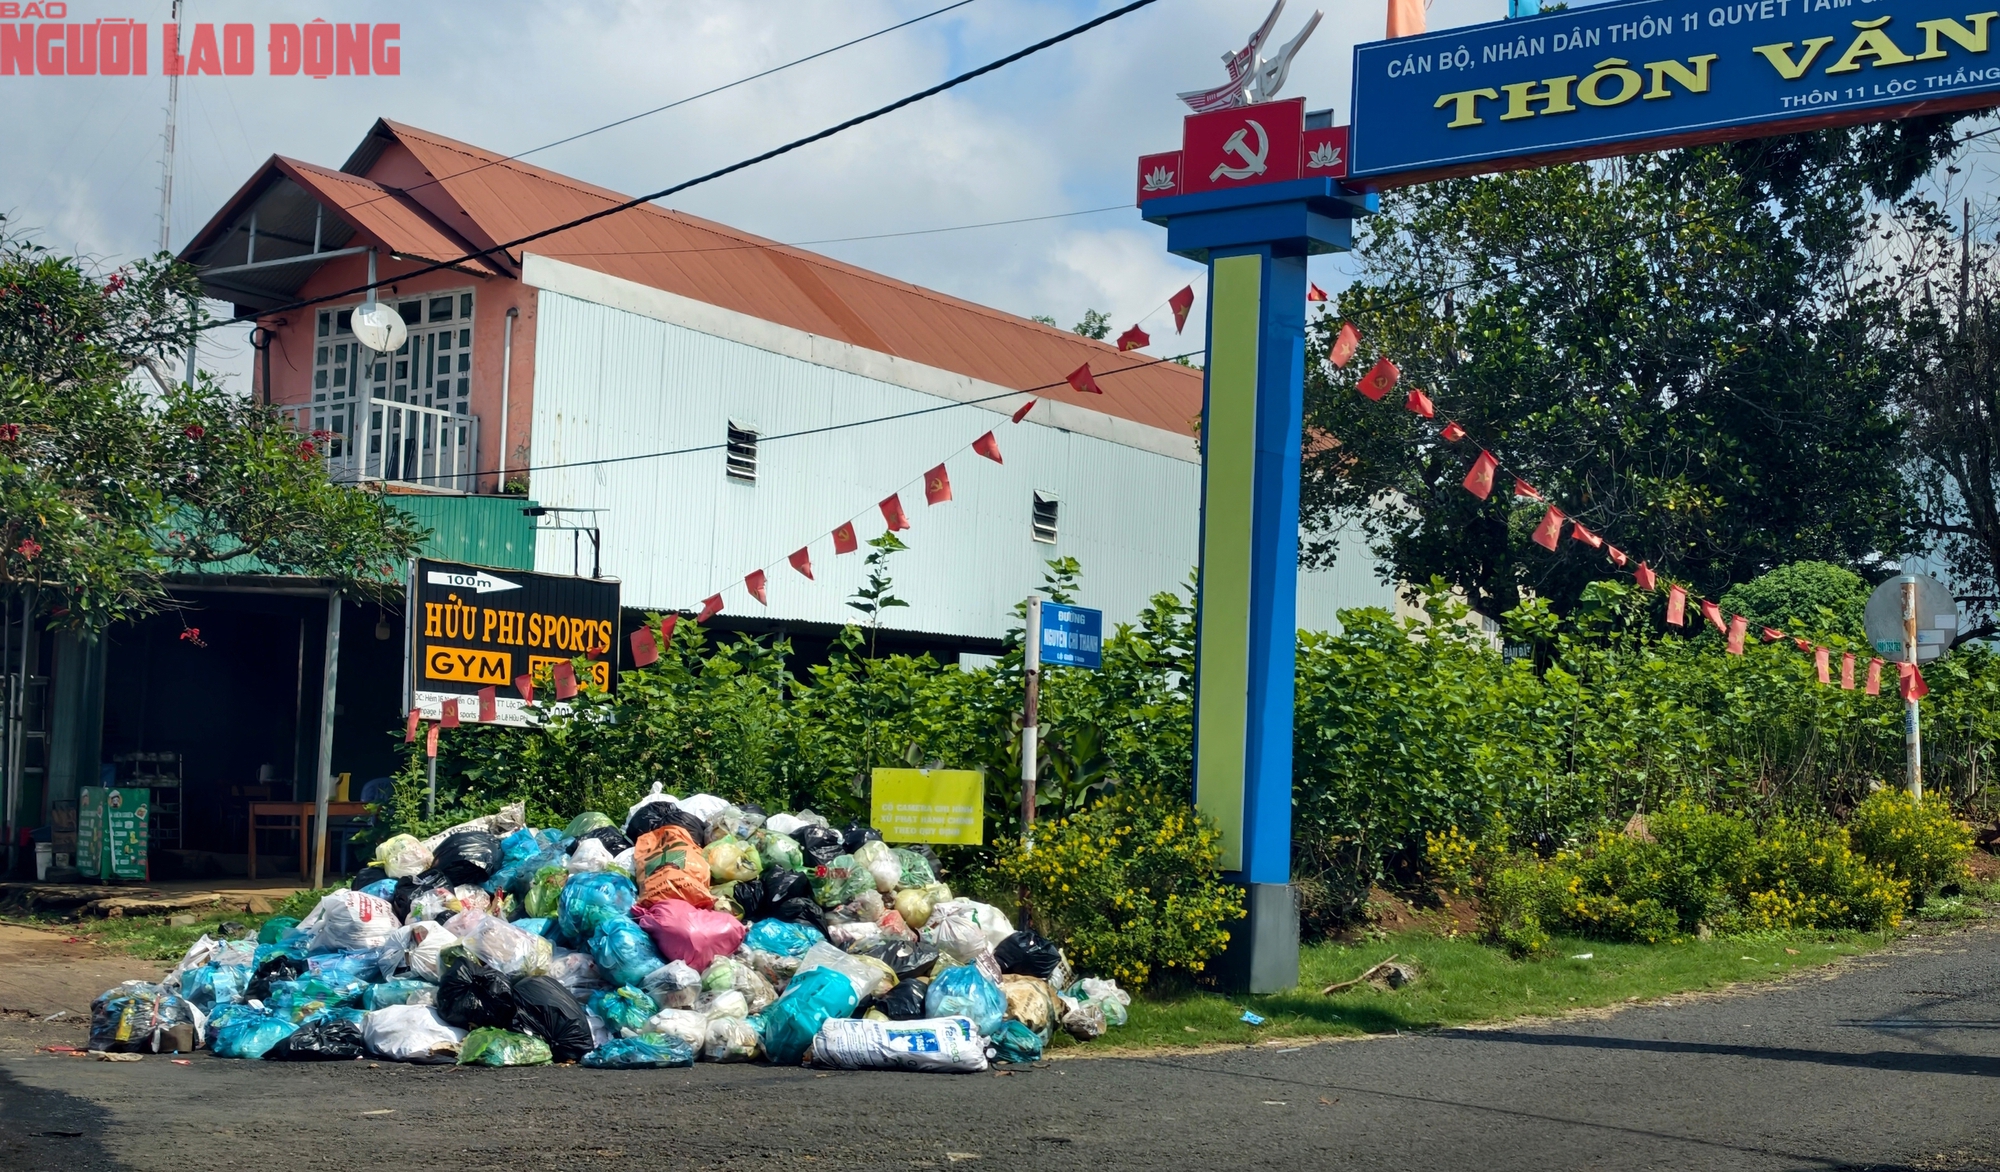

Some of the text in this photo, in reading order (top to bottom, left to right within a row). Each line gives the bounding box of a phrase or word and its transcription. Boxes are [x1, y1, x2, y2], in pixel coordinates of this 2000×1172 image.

[1387, 54, 1431, 78] CÁN
[1439, 45, 1475, 73] BỘ,
[1483, 35, 1545, 63] NHÂN
[1553, 26, 1600, 53] DÂN
[1608, 15, 1672, 43] THÔN
[1681, 12, 1699, 32] 11
[1433, 11, 1999, 128] THÔN VĂN
[1780, 66, 2000, 108] THÔN 11 LỘC THẮNG
[447, 574, 492, 588] 100m
[424, 593, 612, 654] HỮU PHI SPORTS
[1058, 610, 1086, 625] ĐƯỜNG
[431, 651, 506, 680] GYM
